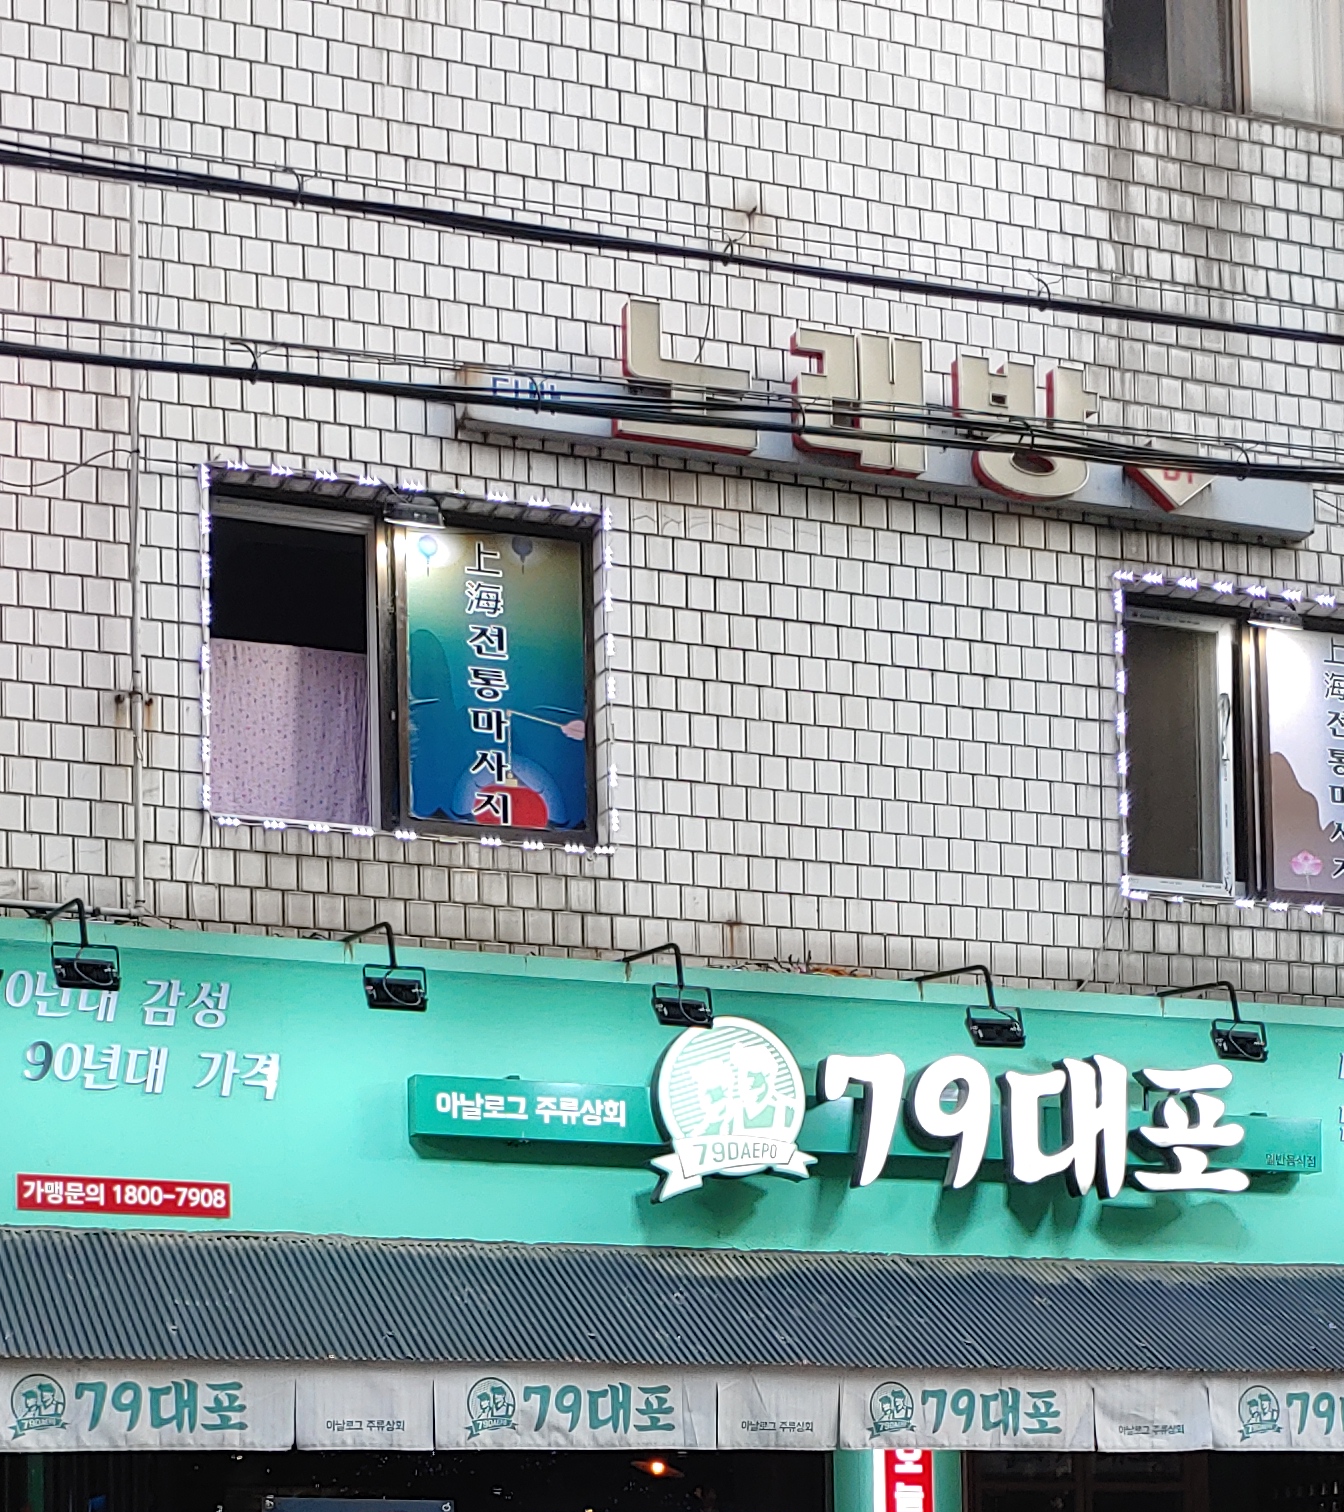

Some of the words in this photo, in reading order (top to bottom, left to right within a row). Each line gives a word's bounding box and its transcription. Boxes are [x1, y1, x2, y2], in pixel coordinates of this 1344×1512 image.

[143, 978, 230, 1030] 감성
[24, 1041, 167, 1094] 90년대
[196, 1050, 281, 1101] 가격
[436, 1090, 529, 1122] 아날로그
[535, 1097, 627, 1128] 주류상회
[819, 1054, 1250, 1199] 79대포
[696, 1141, 779, 1165] 79DAEPO
[23, 1180, 105, 1206] 가맹문의
[112, 1183, 226, 1209] 1800-7908
[74, 1379, 248, 1434] 79대포
[523, 1382, 676, 1435] 79대포
[921, 1387, 1063, 1437] 79대포
